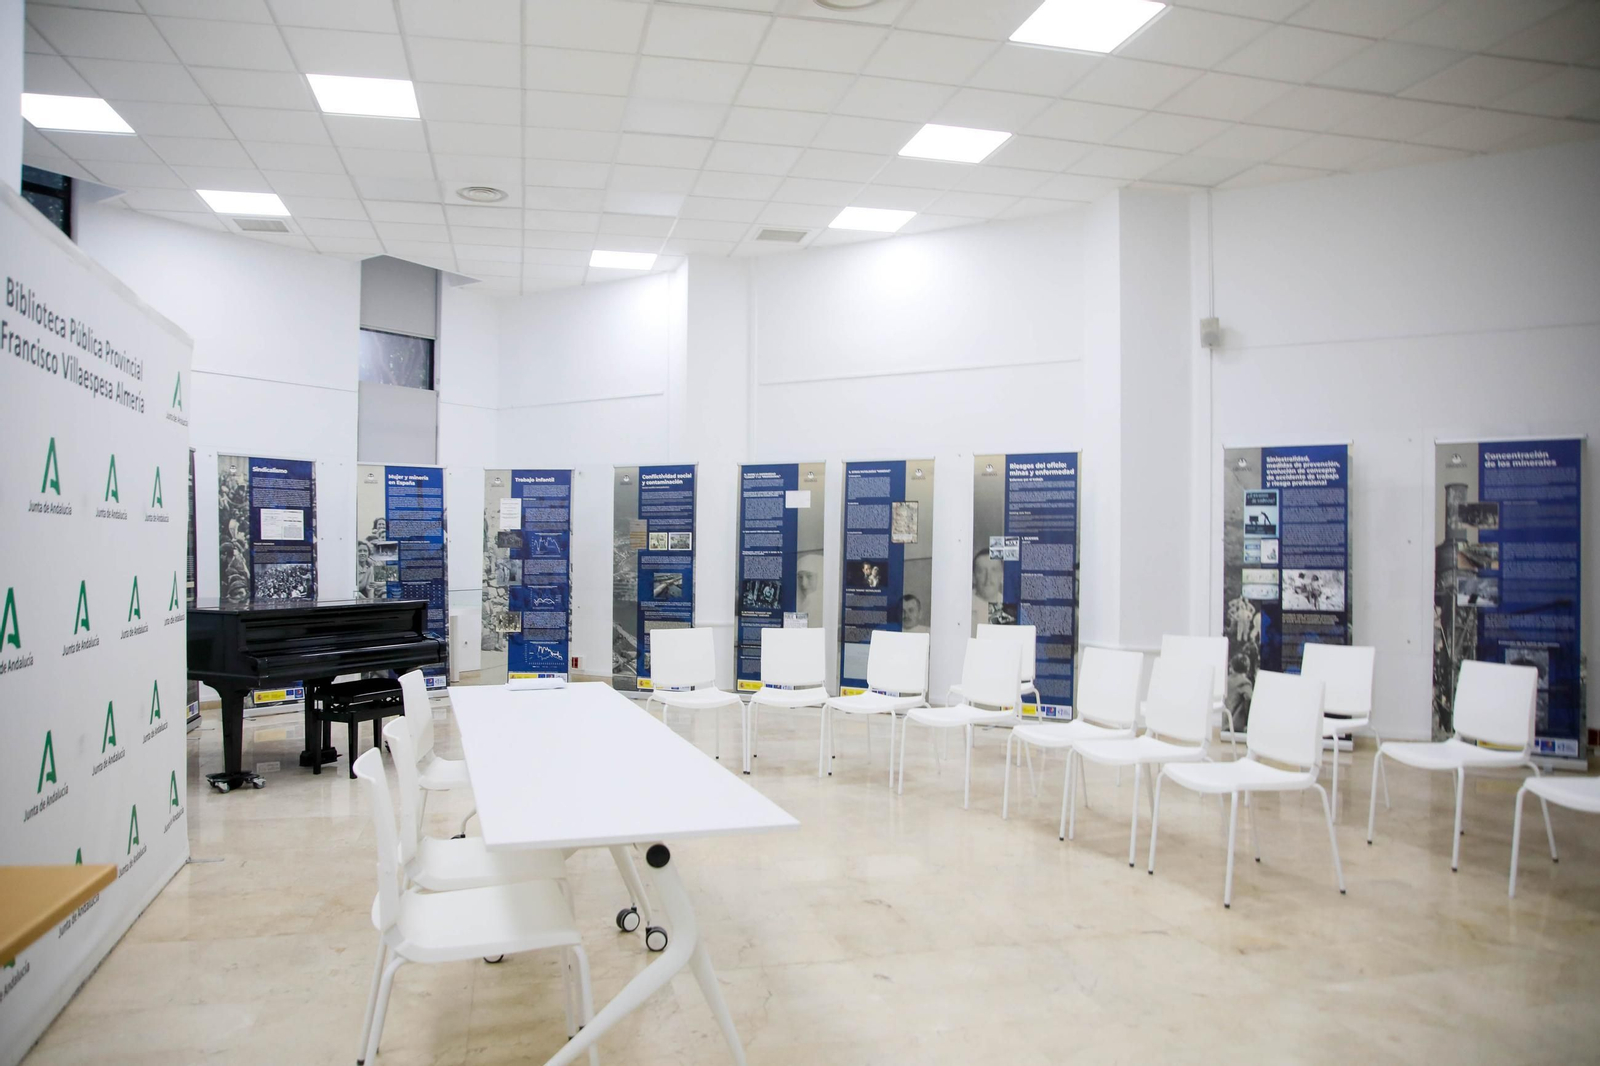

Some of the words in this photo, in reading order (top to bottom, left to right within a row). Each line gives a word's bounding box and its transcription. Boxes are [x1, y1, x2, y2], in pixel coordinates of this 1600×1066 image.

[6, 276, 66, 339] Biblioteca
[70, 317, 103, 360] Pública
[105, 340, 143, 382] Provincial
[1, 319, 58, 375] Francisco
[62, 352, 113, 400] Villaespesa
[115, 381, 144, 413] Almería
[1484, 451, 1549, 460] Concentración
[1512, 458, 1557, 468] minerales
[252, 466, 288, 474] Sindicalismo
[28, 499, 42, 513] Junta
[43, 500, 50, 514] de
[50, 502, 72, 515] Andalucía
[62, 644, 75, 656] Junta
[76, 640, 80, 652] de
[81, 634, 99, 650] Andalucía
[8, 651, 34, 672] Andalucía
[92, 762, 103, 776] Junta
[104, 758, 108, 769] de
[108, 746, 125, 766] Andalucía
[24, 809, 38, 822] Junta
[40, 798, 46, 812] de
[46, 782, 68, 807] Andalucía
[4, 959, 30, 999] Andalucía
